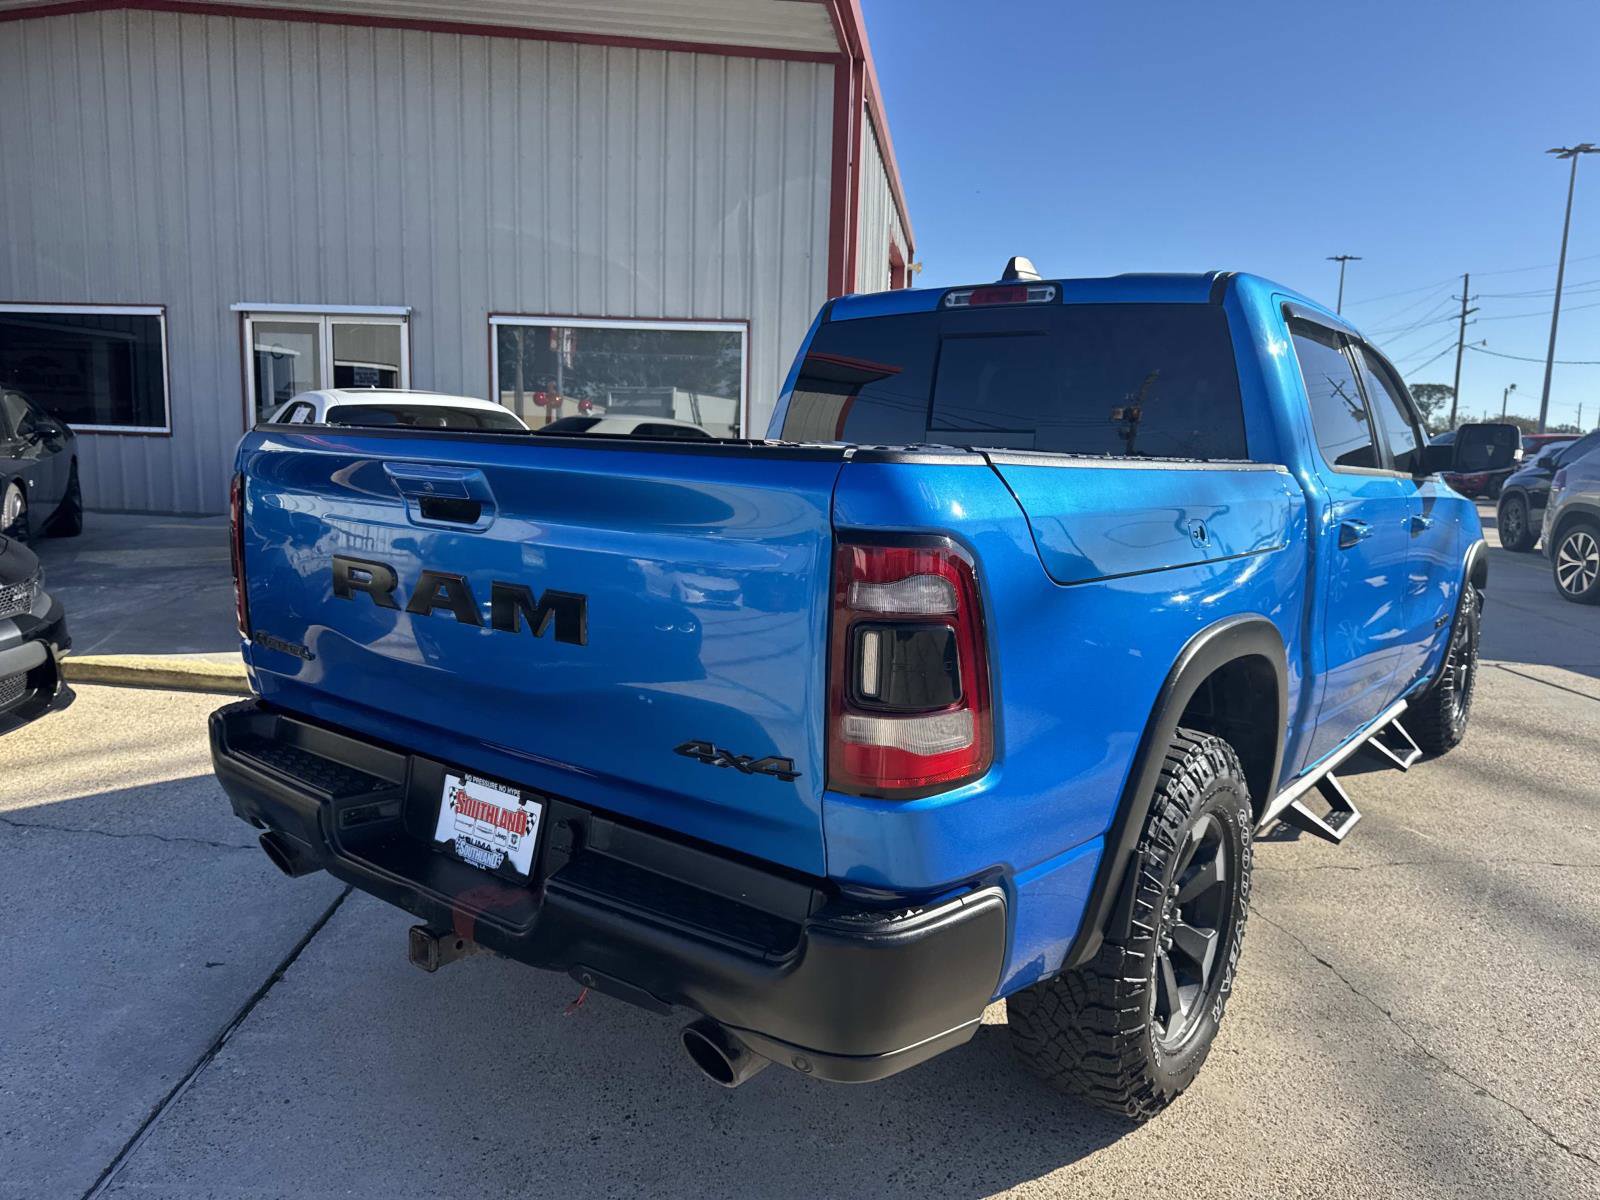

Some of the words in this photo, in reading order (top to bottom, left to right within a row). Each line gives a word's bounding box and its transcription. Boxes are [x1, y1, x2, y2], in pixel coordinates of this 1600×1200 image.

[332, 554, 589, 647] RAM
[464, 773, 472, 781] NO
[473, 776, 498, 790] PRESSURE
[498, 784, 506, 793] NO
[507, 786, 521, 798] HYPE
[455, 790, 528, 837] SOUTHLAND
[459, 840, 497, 867] SOUTHLAND
[1210, 808, 1252, 1024] GOODYEAR
